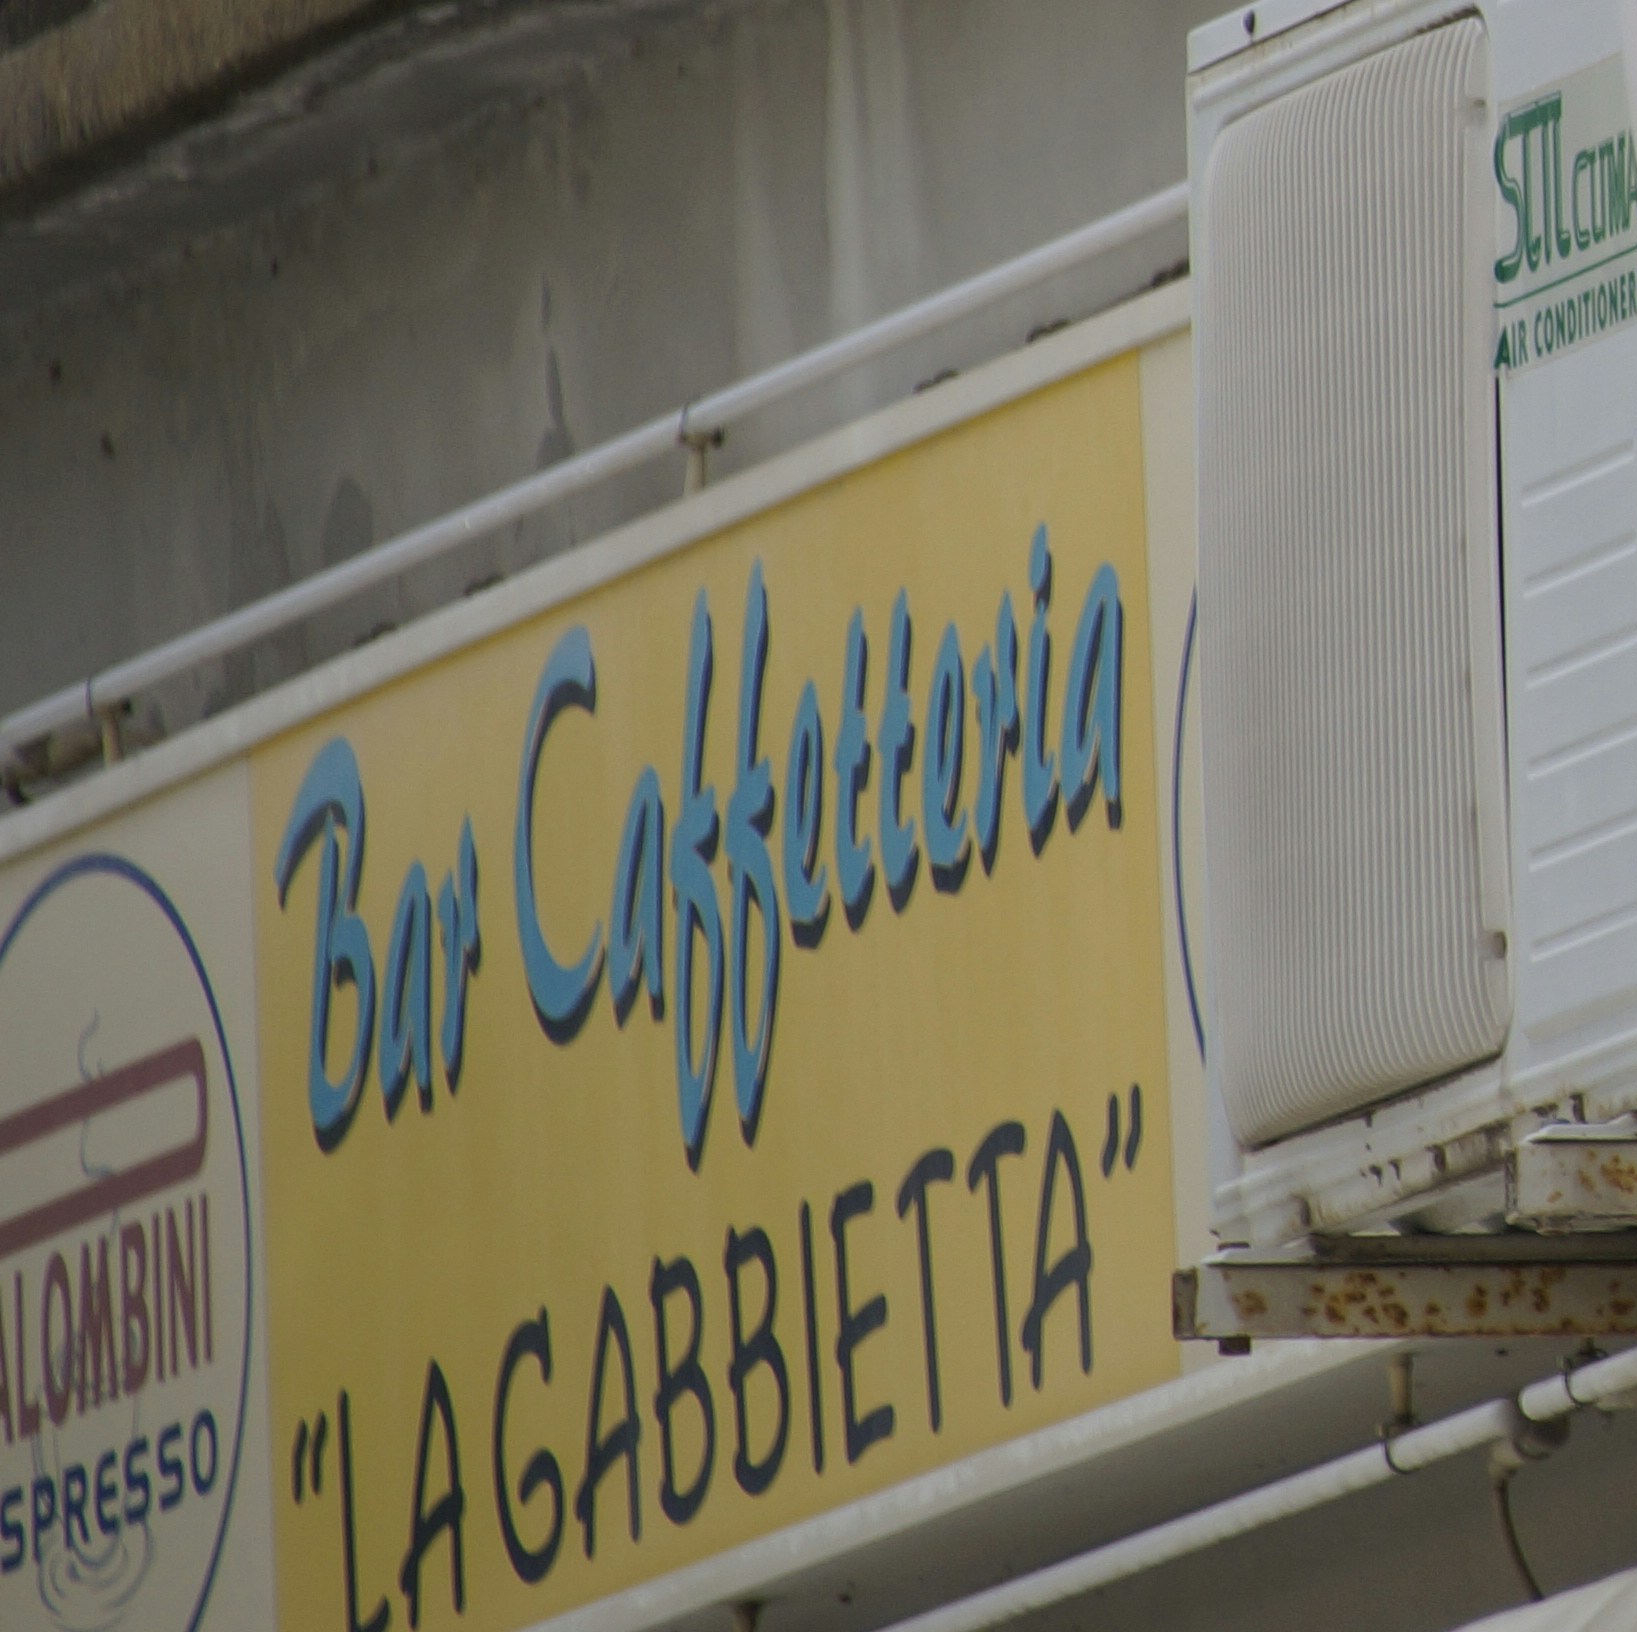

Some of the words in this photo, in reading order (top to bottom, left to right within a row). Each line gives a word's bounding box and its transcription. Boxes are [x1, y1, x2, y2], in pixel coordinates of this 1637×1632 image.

[1494, 319, 1529, 369] AIR
[275, 736, 482, 1154] Bar
[514, 521, 1123, 1174] Caffetteria
[0, 1408, 218, 1568] SPRESSO
